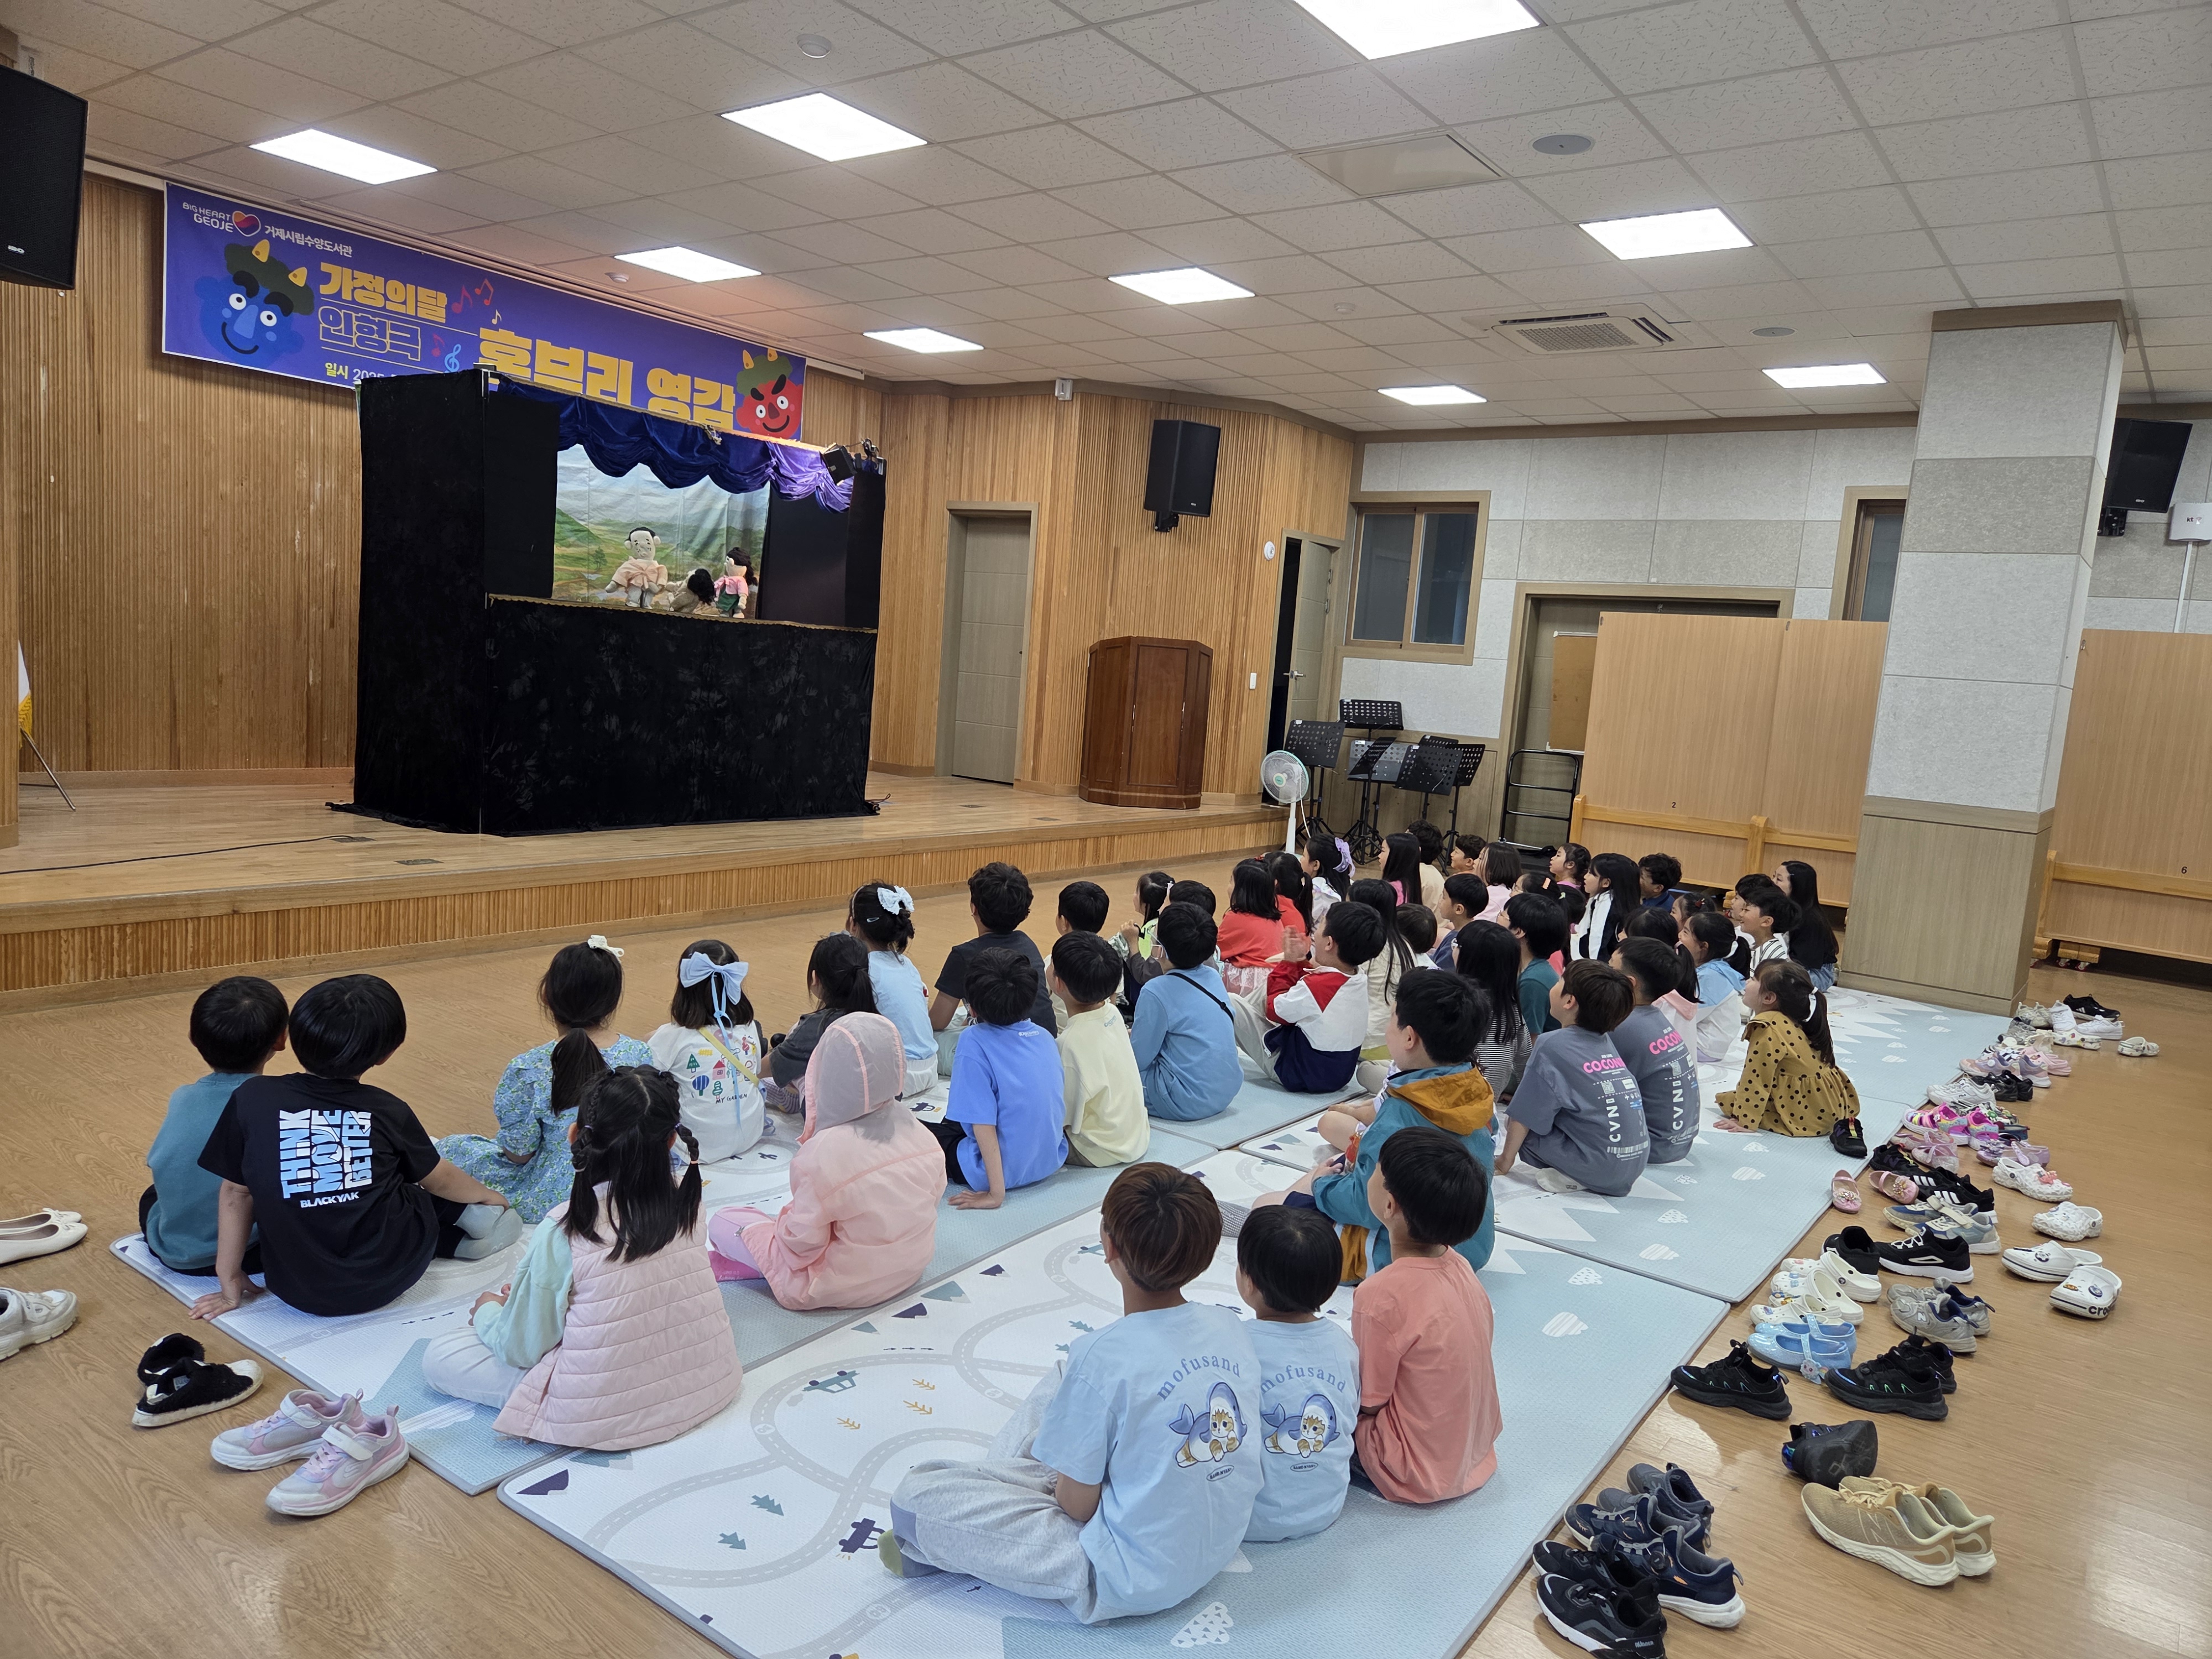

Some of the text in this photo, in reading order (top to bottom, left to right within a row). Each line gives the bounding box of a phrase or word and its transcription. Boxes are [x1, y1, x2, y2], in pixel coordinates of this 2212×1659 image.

[182, 202, 231, 221] BIG HEART
[194, 213, 233, 233] GEOJE
[265, 225, 352, 258] 거제시립수양도서관
[320, 262, 447, 324] 가정의달
[319, 306, 421, 362] 인형극
[325, 362, 348, 379] 일시
[2181, 866, 2187, 874] 6
[279, 1109, 312, 1199] THINK
[311, 1109, 344, 1193] MOVE
[342, 1110, 373, 1189] BETTER
[300, 1191, 359, 1208] BLACKYAK
[1156, 1355, 1240, 1401] mofusand
[1260, 1364, 1346, 1396] mofusand
